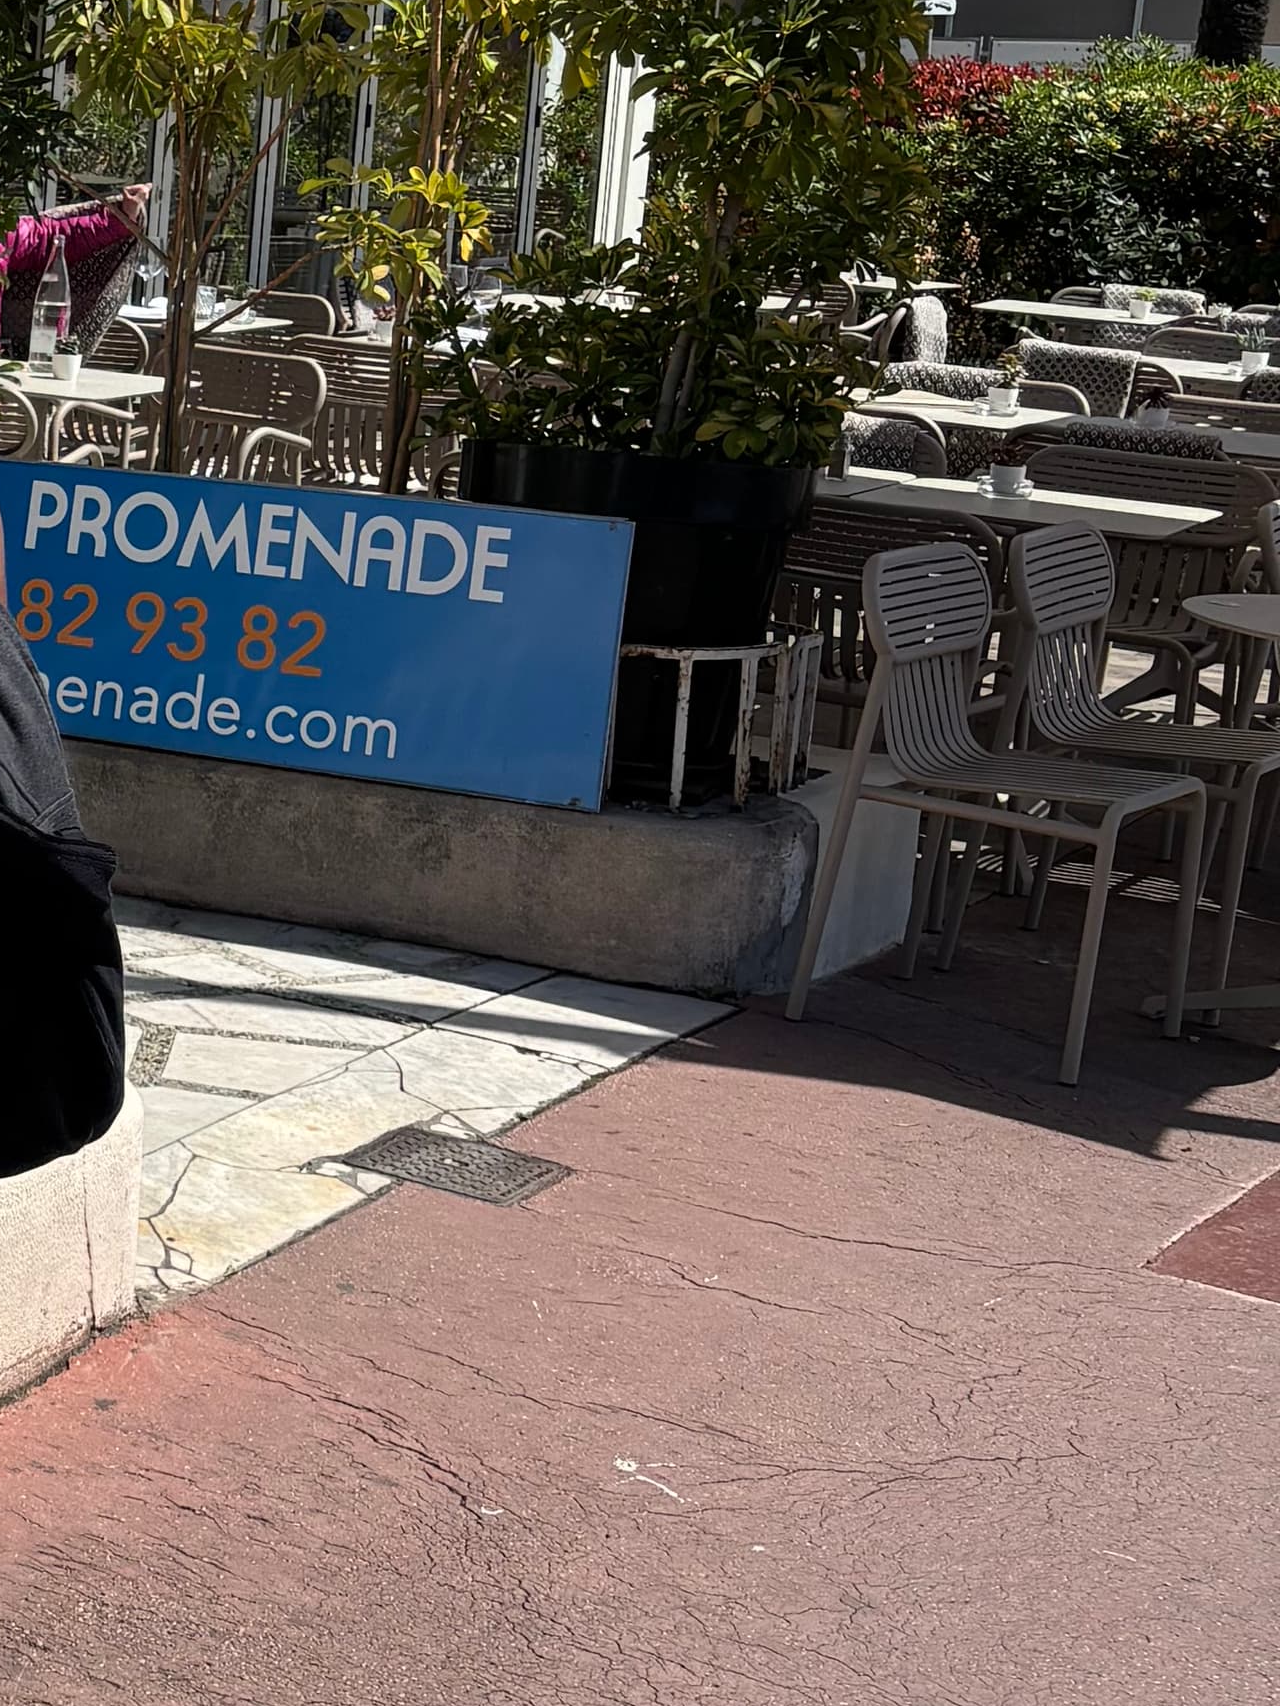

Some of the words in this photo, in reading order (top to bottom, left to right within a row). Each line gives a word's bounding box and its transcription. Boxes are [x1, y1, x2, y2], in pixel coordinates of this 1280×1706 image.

[24, 479, 512, 604] PROMENADE
[16, 578, 98, 648] 82
[125, 592, 208, 661] 93
[237, 604, 327, 677] 82
[40, 673, 397, 759] enade.com
